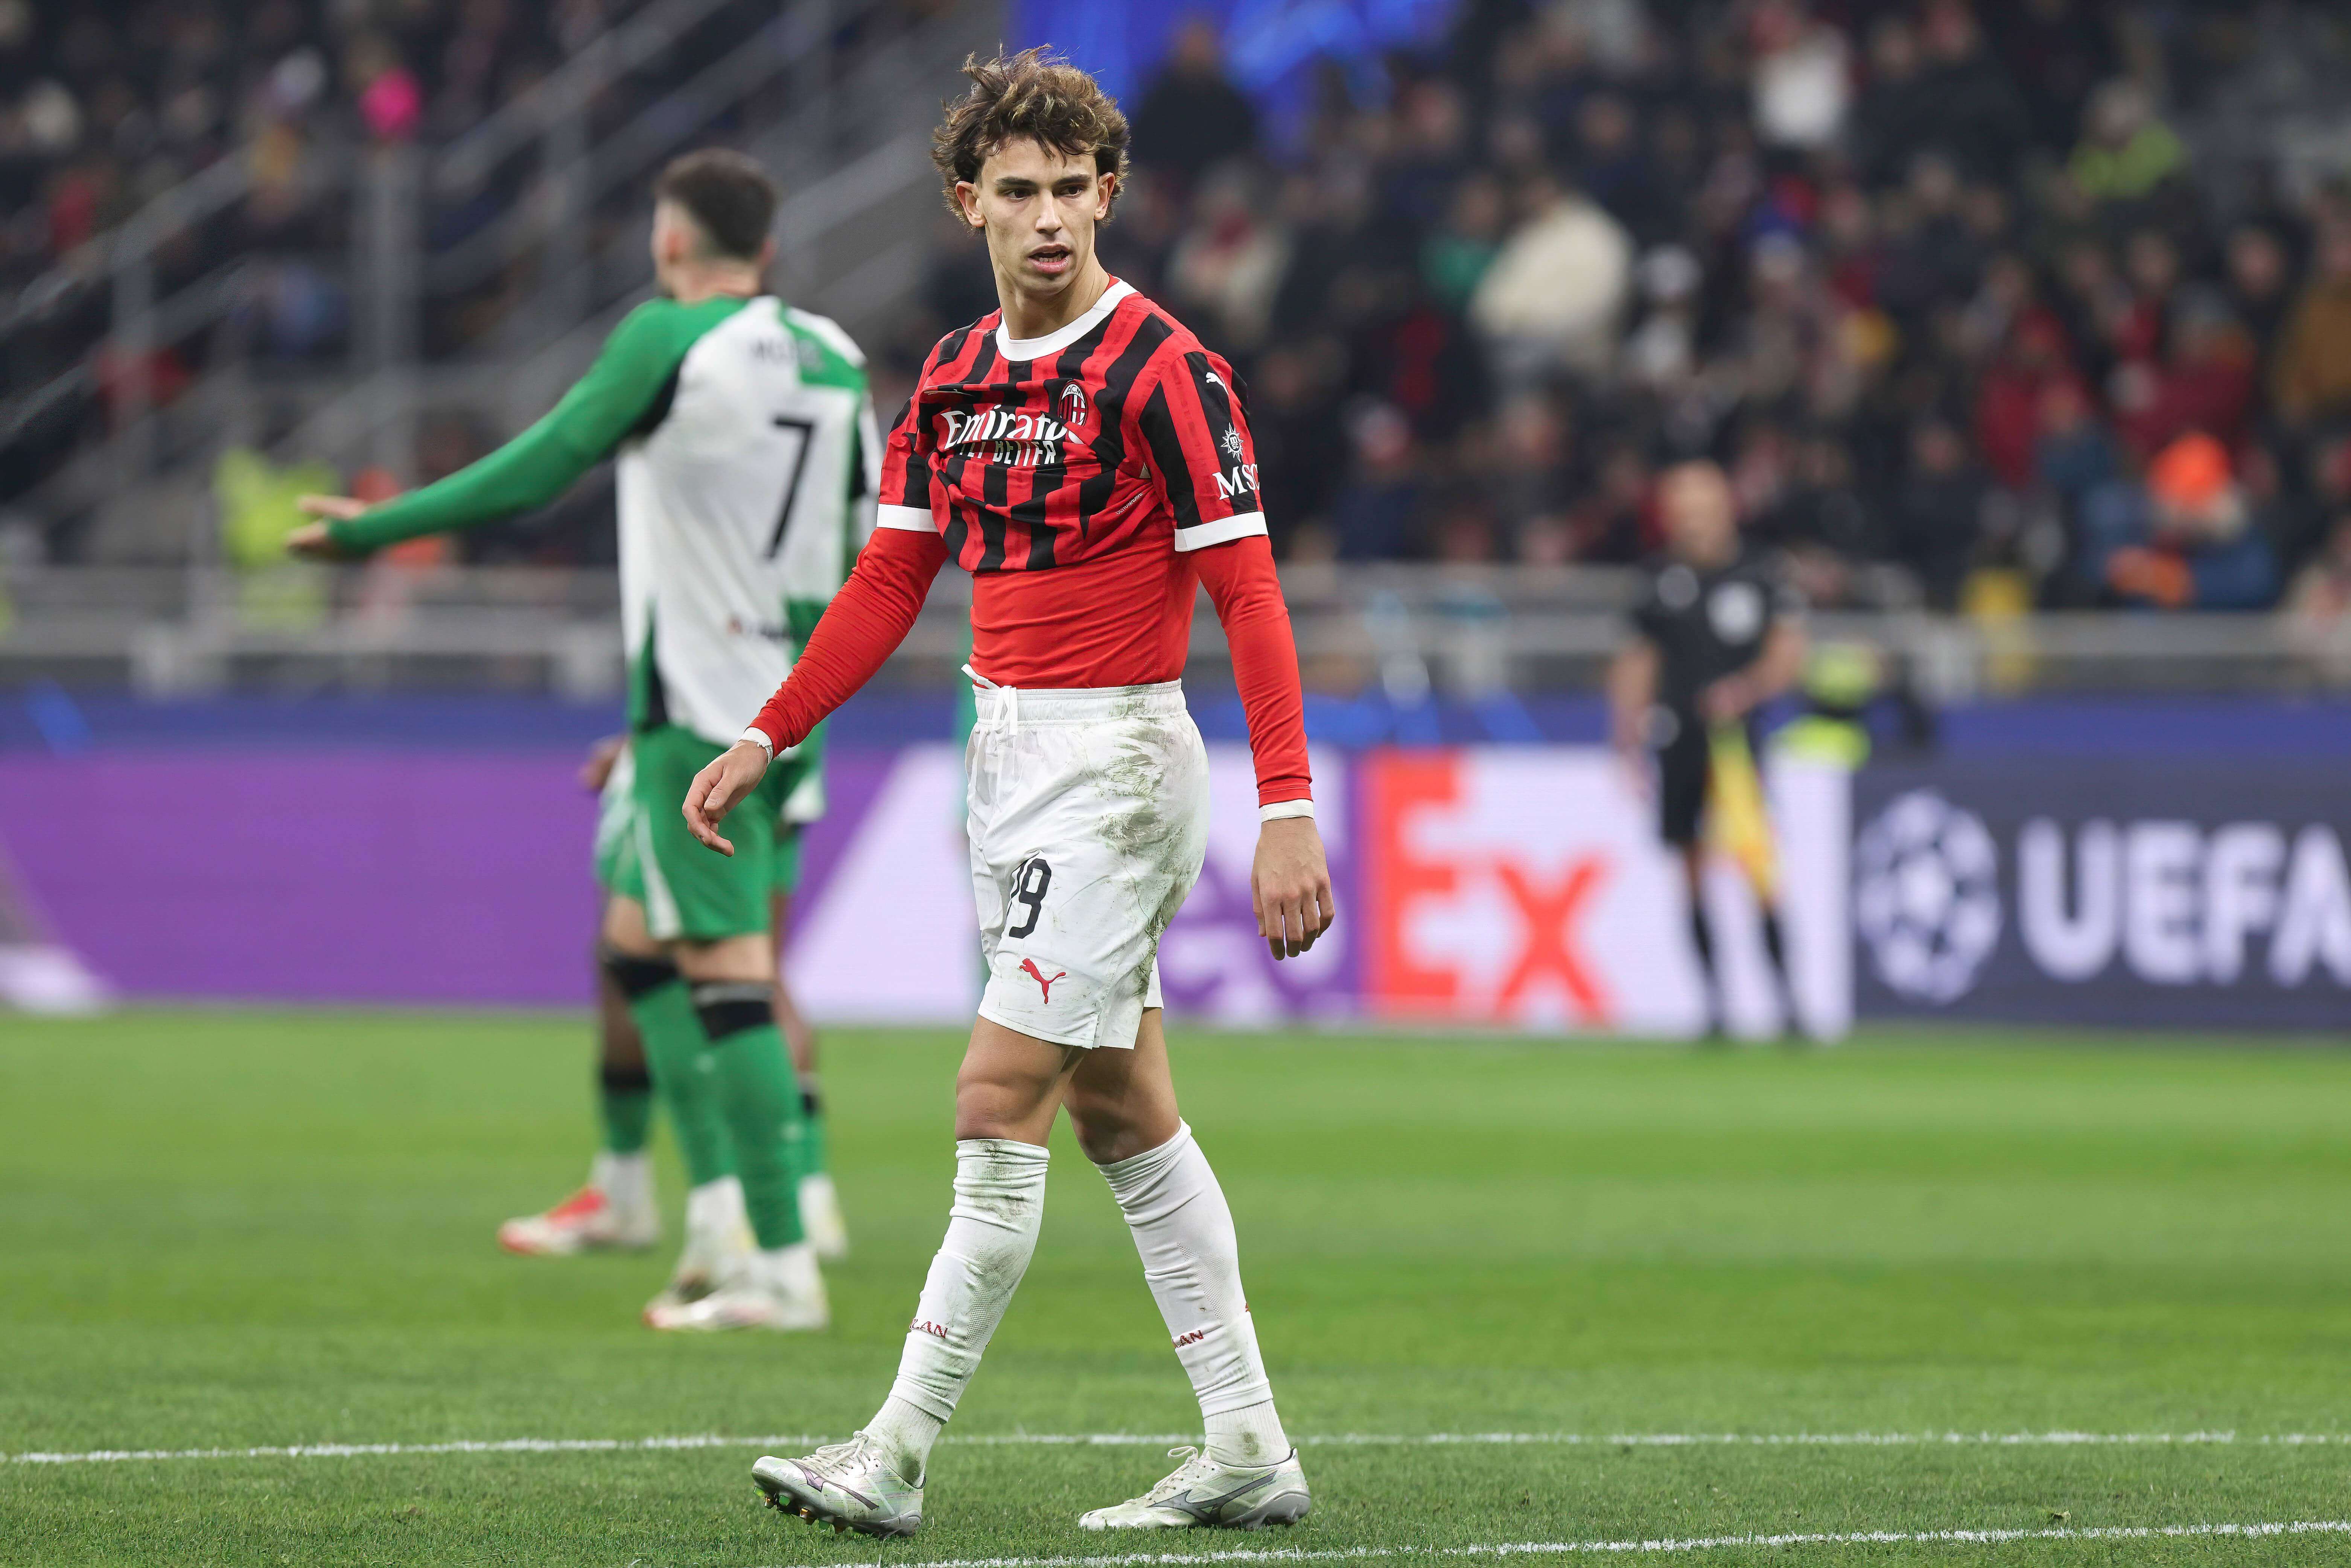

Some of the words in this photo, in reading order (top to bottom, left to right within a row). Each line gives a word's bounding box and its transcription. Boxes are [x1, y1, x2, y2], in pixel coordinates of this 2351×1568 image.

[1065, 386, 1082, 397] ACM
[767, 416, 815, 561] 7
[1212, 463, 1260, 500] MSC
[1005, 854, 1052, 939] 9
[1159, 744, 1615, 1024] edEx
[2016, 815, 2351, 988] UEFA
